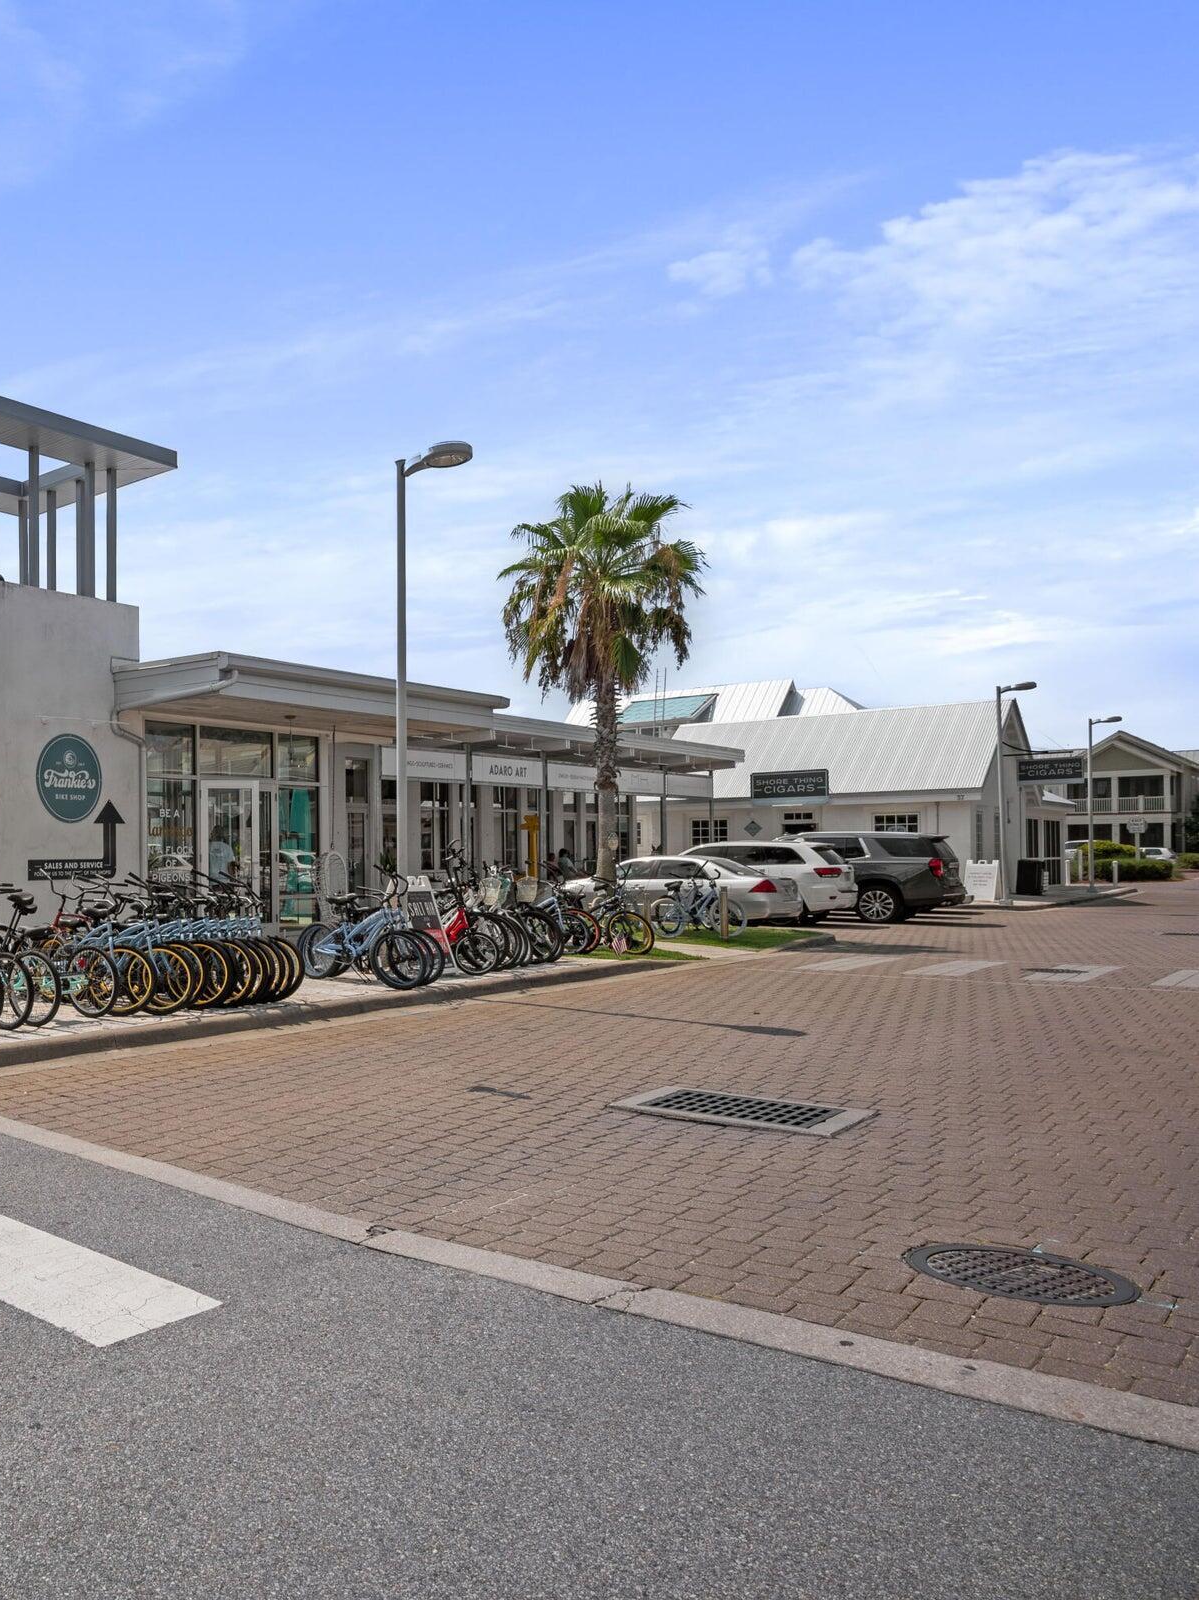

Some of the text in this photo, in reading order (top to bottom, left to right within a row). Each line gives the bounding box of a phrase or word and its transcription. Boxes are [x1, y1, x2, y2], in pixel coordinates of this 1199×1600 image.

[489, 764, 528, 778] ADARO ART
[1027, 768, 1073, 777] CIGARS
[794, 776, 823, 784] THING
[764, 783, 815, 794] CIGARS
[159, 809, 180, 818] BE A
[165, 846, 194, 856] FLOCK
[44, 862, 62, 870] SALES
[80, 861, 103, 869] SERVICE
[165, 860, 177, 868] OF
[152, 873, 191, 883] PIGEONS
